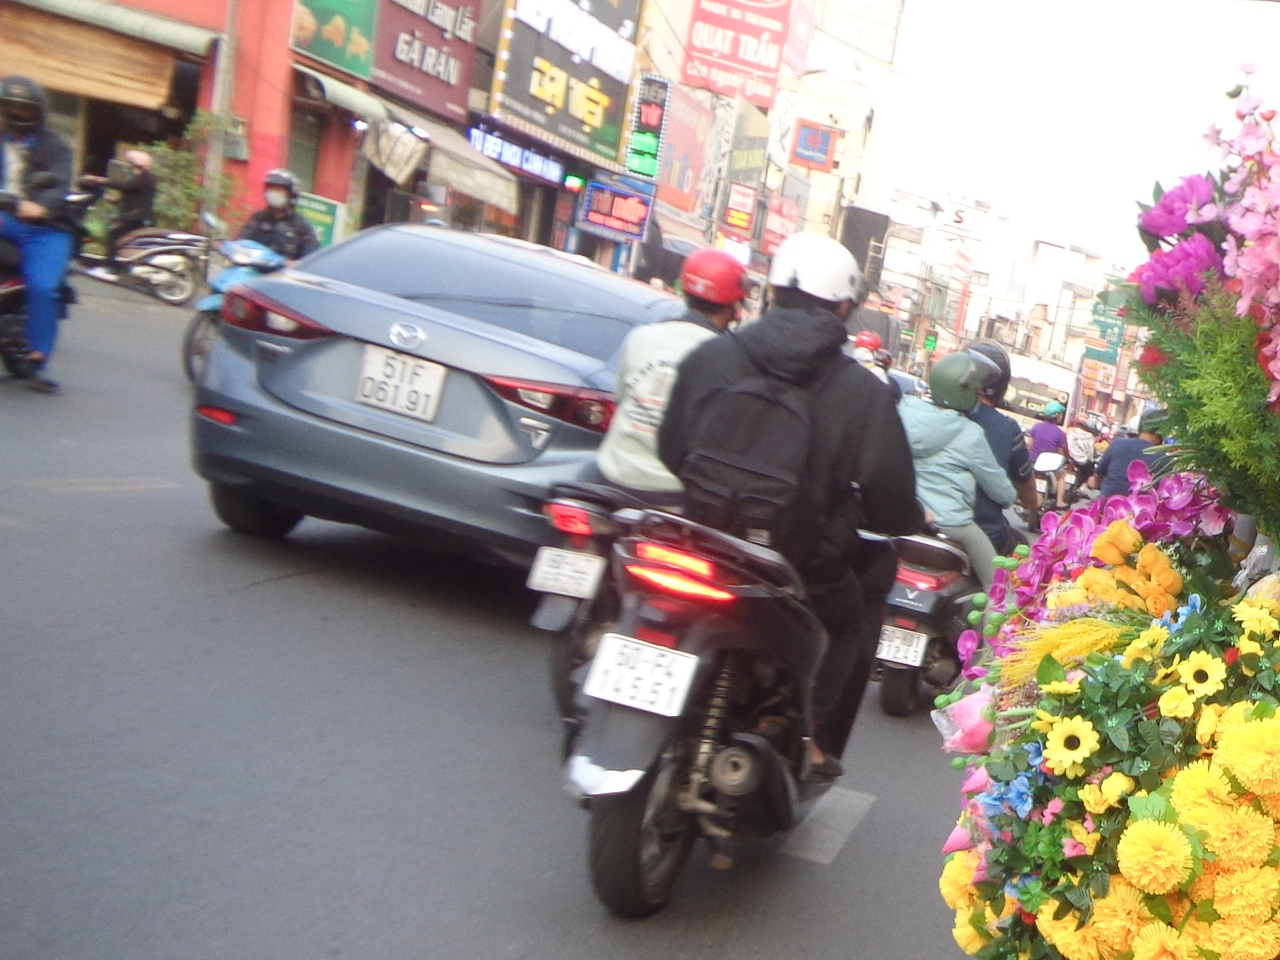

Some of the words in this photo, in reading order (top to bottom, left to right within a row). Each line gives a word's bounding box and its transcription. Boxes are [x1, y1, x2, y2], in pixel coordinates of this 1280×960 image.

[394, 29, 421, 69] GÀ
[691, 21, 736, 57] QUẠT
[382, 354, 426, 387] 51F
